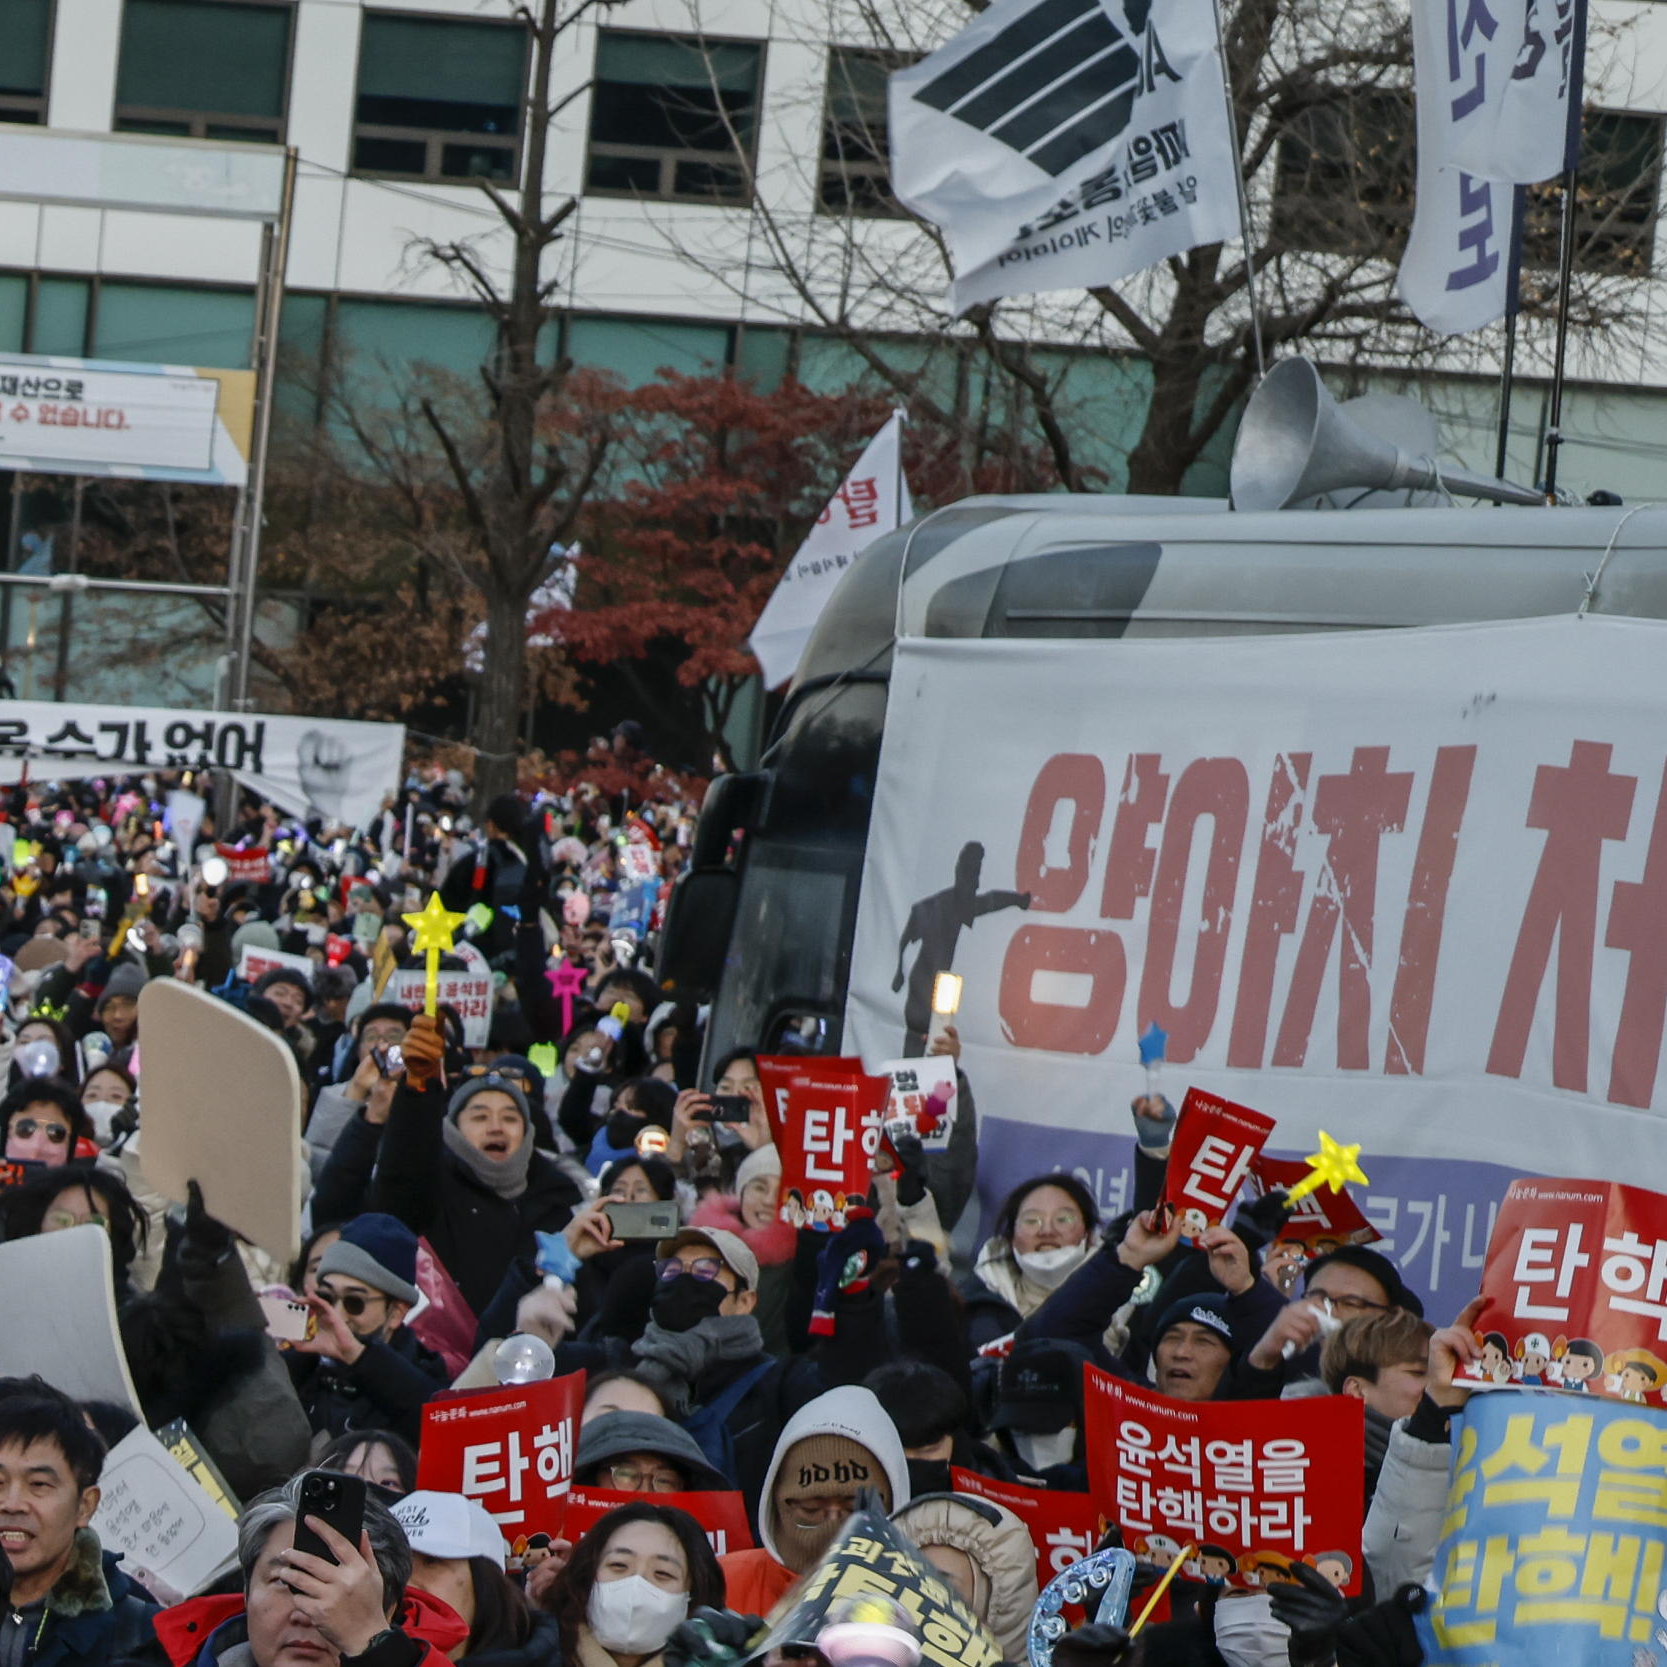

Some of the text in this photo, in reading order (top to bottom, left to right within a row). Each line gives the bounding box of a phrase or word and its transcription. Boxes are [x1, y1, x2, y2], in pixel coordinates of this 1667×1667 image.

[10, 402, 29, 423] 수
[38, 402, 131, 430] 없습니다.
[997, 742, 1478, 1076] 양아치
[1538, 1188, 1603, 1205] www.nanum.com
[468, 1400, 527, 1419] www.nanum.com
[1124, 1393, 1199, 1424] www.nanum.com
[462, 1417, 573, 1525] 탄핵
[1116, 1420, 1310, 1493] 윤석열을
[1116, 1474, 1312, 1551] 탄핵하라
